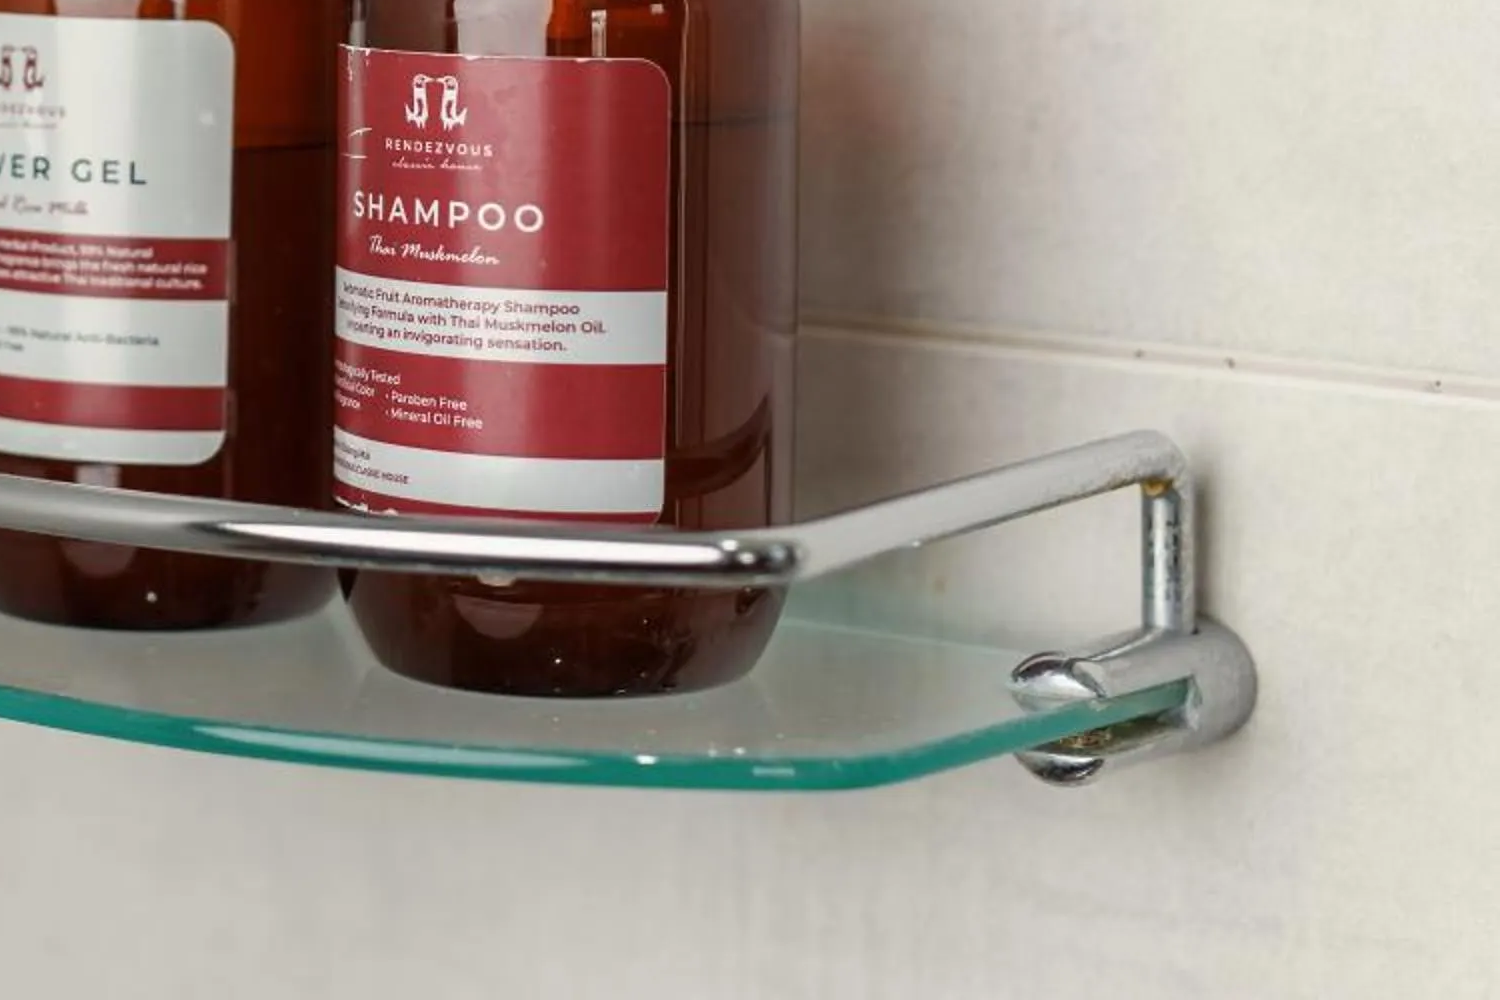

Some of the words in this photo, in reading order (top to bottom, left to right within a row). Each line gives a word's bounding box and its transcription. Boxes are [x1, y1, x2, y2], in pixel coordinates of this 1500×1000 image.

[385, 137, 494, 157] RENDEZVOUS
[71, 158, 148, 186] GEL
[391, 156, 436, 170] classic
[353, 189, 545, 233] SHAMPOO
[106, 244, 154, 259] Natural
[368, 234, 397, 256] Thai
[399, 241, 500, 266] Muskmelon
[79, 258, 100, 271] the
[102, 258, 136, 273] fresh
[138, 261, 182, 275] natural
[183, 262, 208, 276] rice
[89, 272, 153, 289] traditional
[155, 276, 204, 291] culture.
[375, 287, 400, 304] Fruit
[402, 291, 500, 314] Aromatherapy
[503, 299, 581, 317] Shampoo
[371, 304, 414, 324] Formula
[417, 310, 446, 326] with
[449, 314, 481, 330] Thai
[484, 316, 576, 334] Muskmelon
[579, 320, 607, 335] Oil.
[30, 327, 73, 343] Natural
[75, 330, 160, 348] Anti-Bacteria
[387, 327, 401, 340] an
[403, 326, 483, 350] invigorating
[486, 336, 568, 353] sensation.
[371, 369, 401, 386] Tested
[391, 389, 437, 408] Paraben
[438, 395, 468, 411] Free
[390, 407, 431, 424] Mineral
[433, 412, 451, 425] Oil
[453, 415, 484, 430] Free
